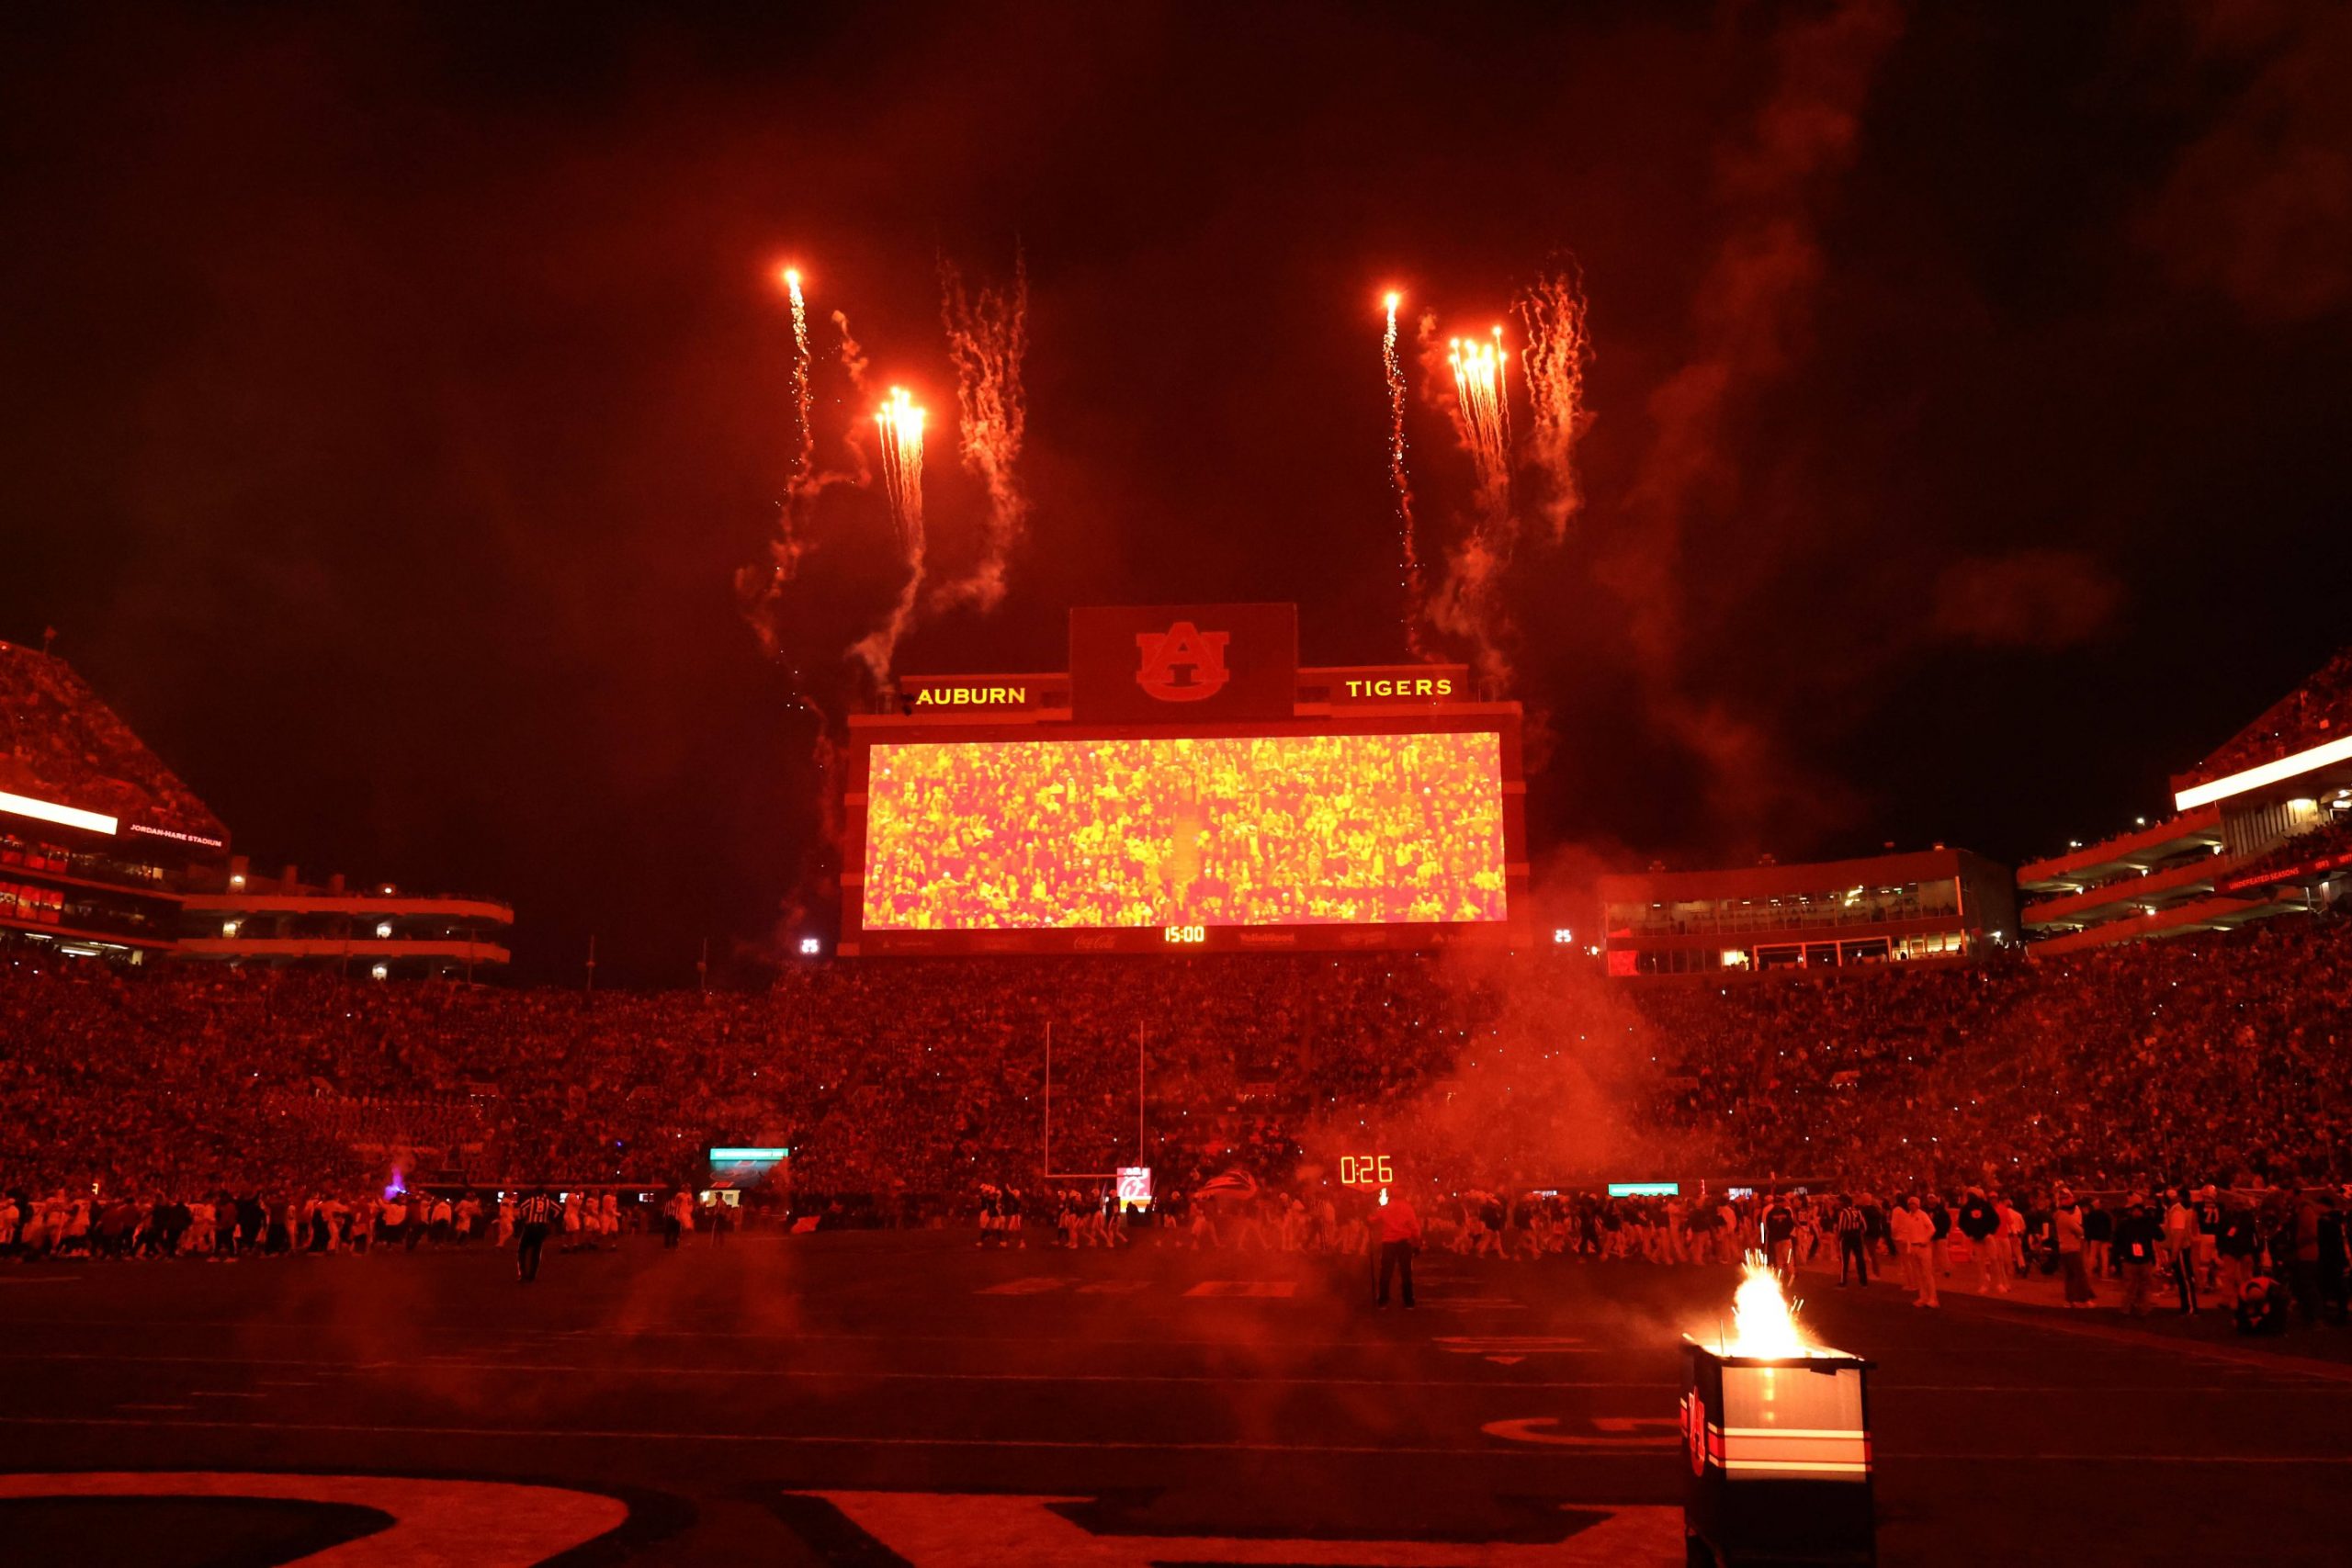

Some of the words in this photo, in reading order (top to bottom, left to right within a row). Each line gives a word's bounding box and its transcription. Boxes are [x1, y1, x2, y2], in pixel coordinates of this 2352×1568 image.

[916, 687, 1027, 706] AUBURN
[1346, 679, 1453, 697] TIGERS
[130, 824, 187, 840] JORDAN-HARE
[187, 835, 222, 847] STADIUM
[2230, 875, 2269, 889] UNDEFEATED
[2271, 868, 2299, 879] SEASONS
[1165, 925, 1204, 942] 15:00
[1555, 929, 1572, 942] 25
[1341, 1156, 1393, 1183] 0:26
[2203, 1208, 2219, 1223] 71
